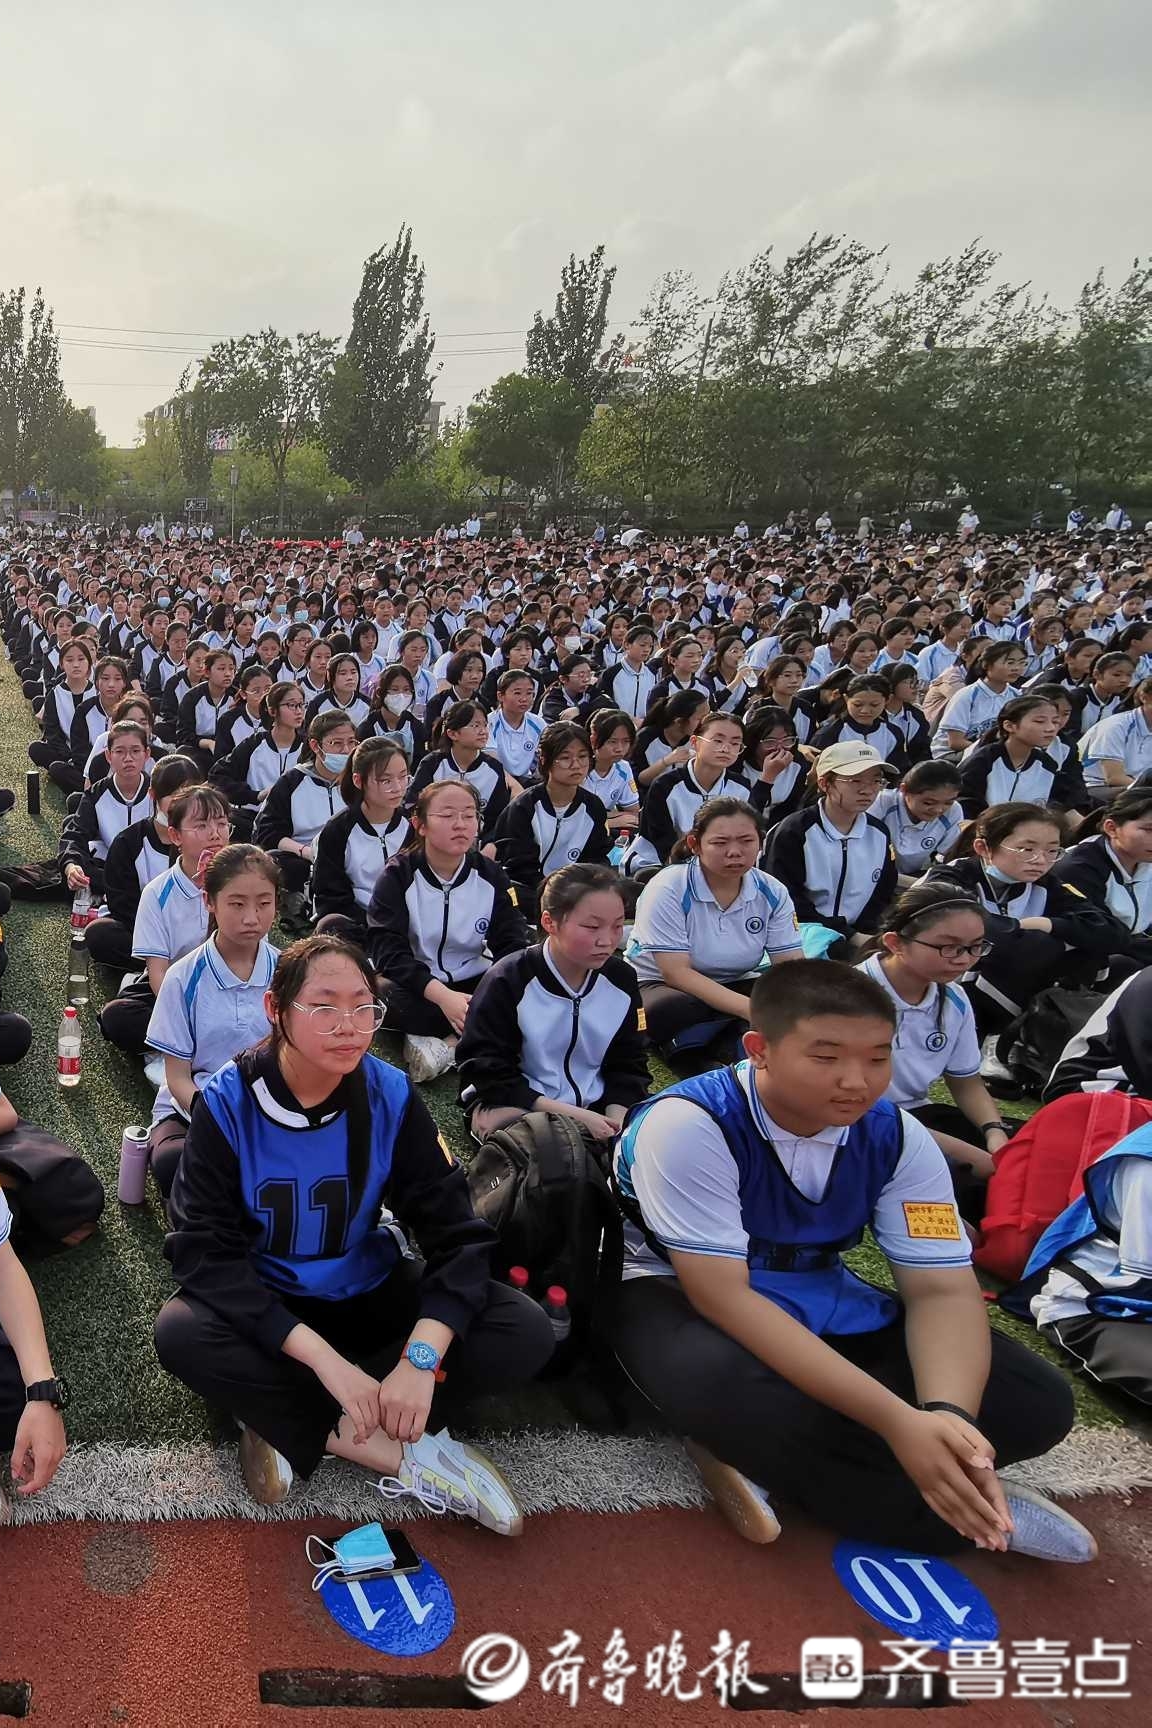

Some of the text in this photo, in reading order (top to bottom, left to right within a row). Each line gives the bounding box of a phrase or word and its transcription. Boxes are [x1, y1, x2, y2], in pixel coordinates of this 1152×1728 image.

[254, 1174, 350, 1257] 11
[346, 1573, 435, 1631] 11
[851, 1556, 972, 1625] 10
